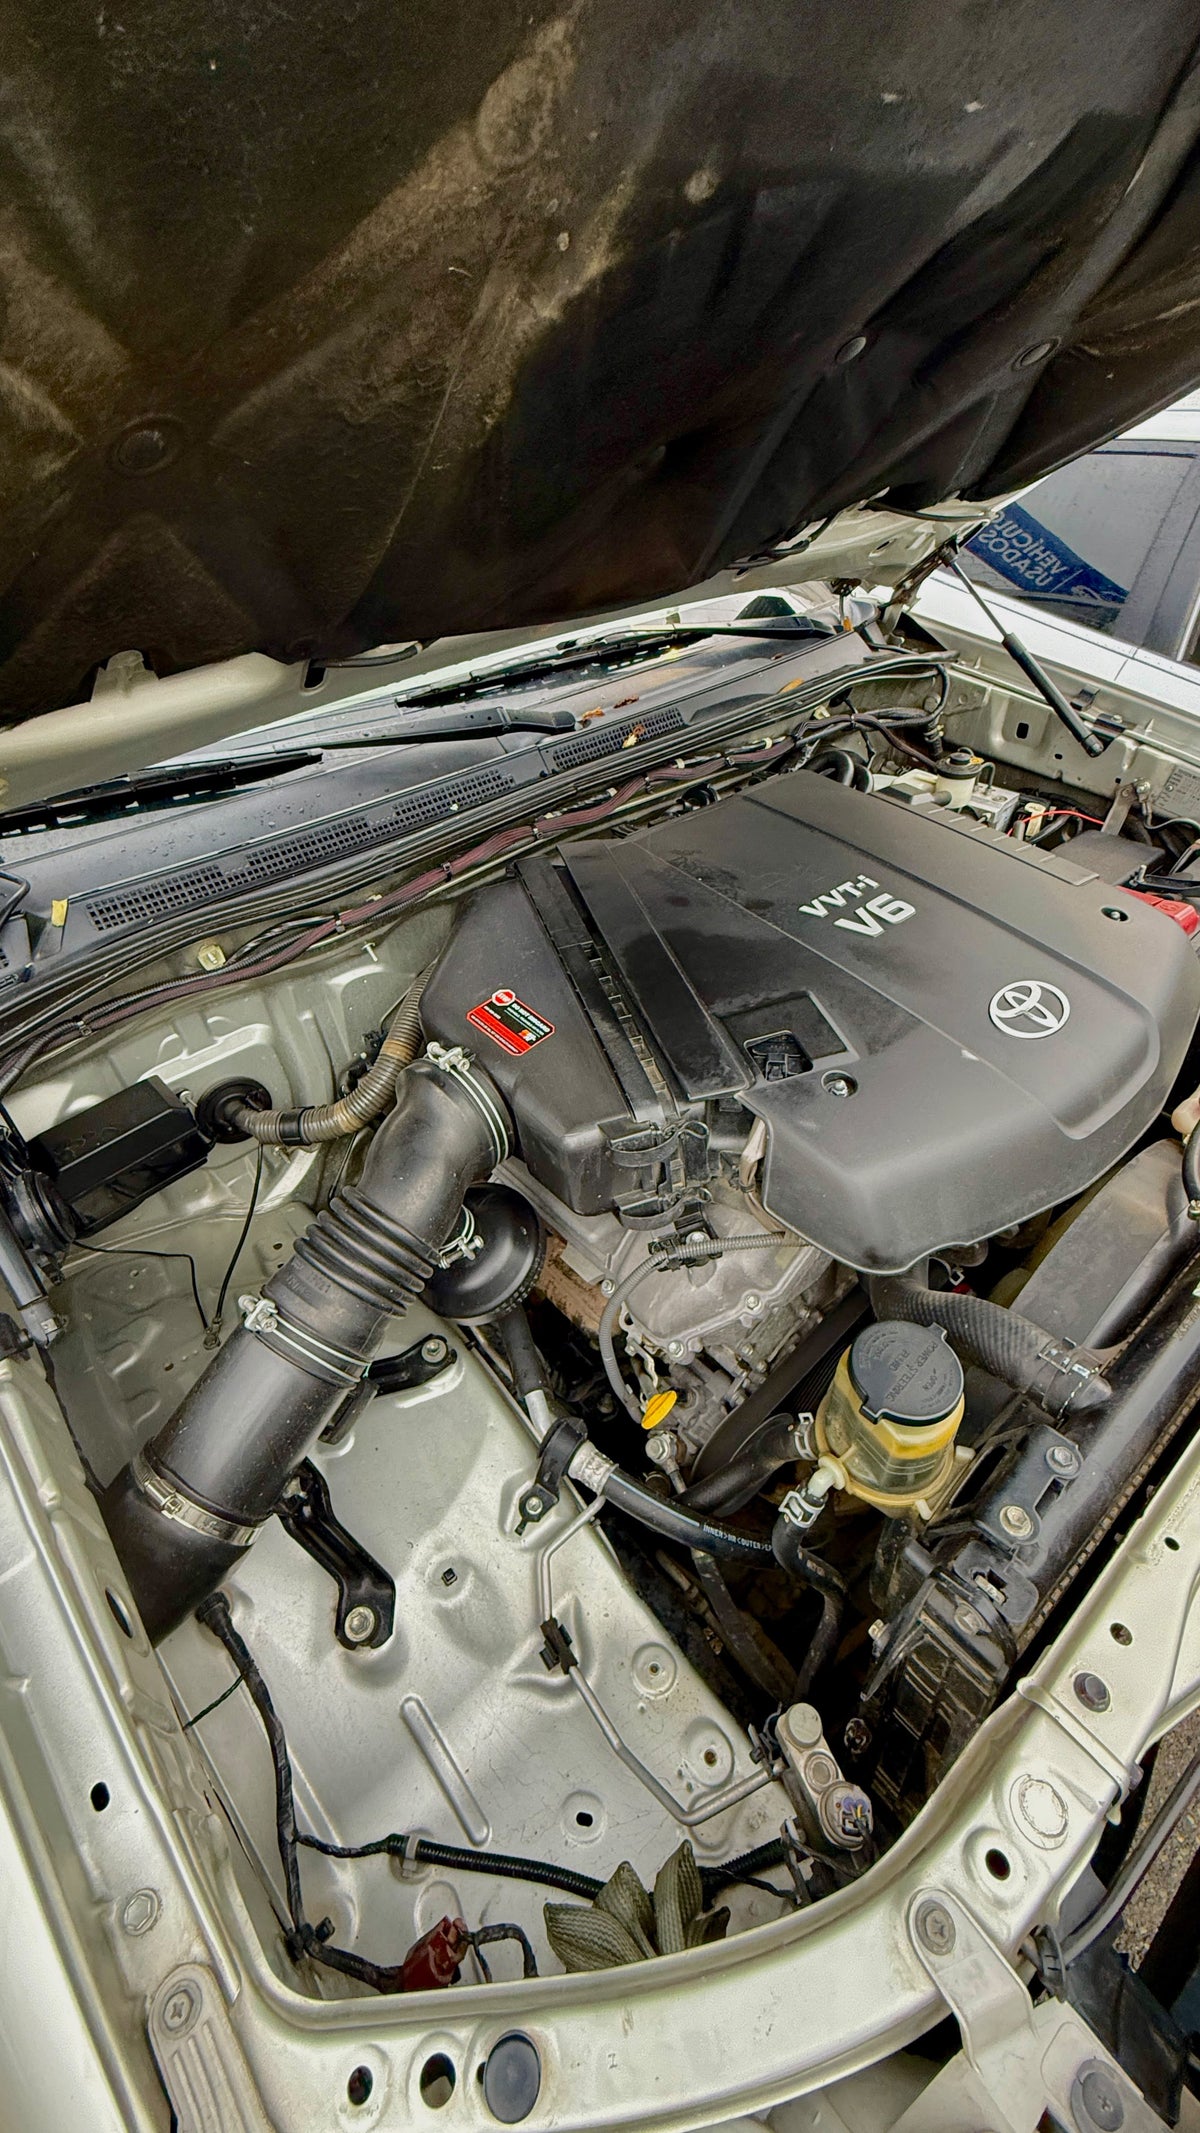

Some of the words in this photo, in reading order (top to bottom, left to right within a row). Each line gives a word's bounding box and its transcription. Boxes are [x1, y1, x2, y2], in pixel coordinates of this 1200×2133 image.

[798, 874, 880, 918] VVT-i
[833, 893, 916, 937] V6
[917, 1340, 938, 1367] POWER
[885, 1366, 919, 1401] STEERING
